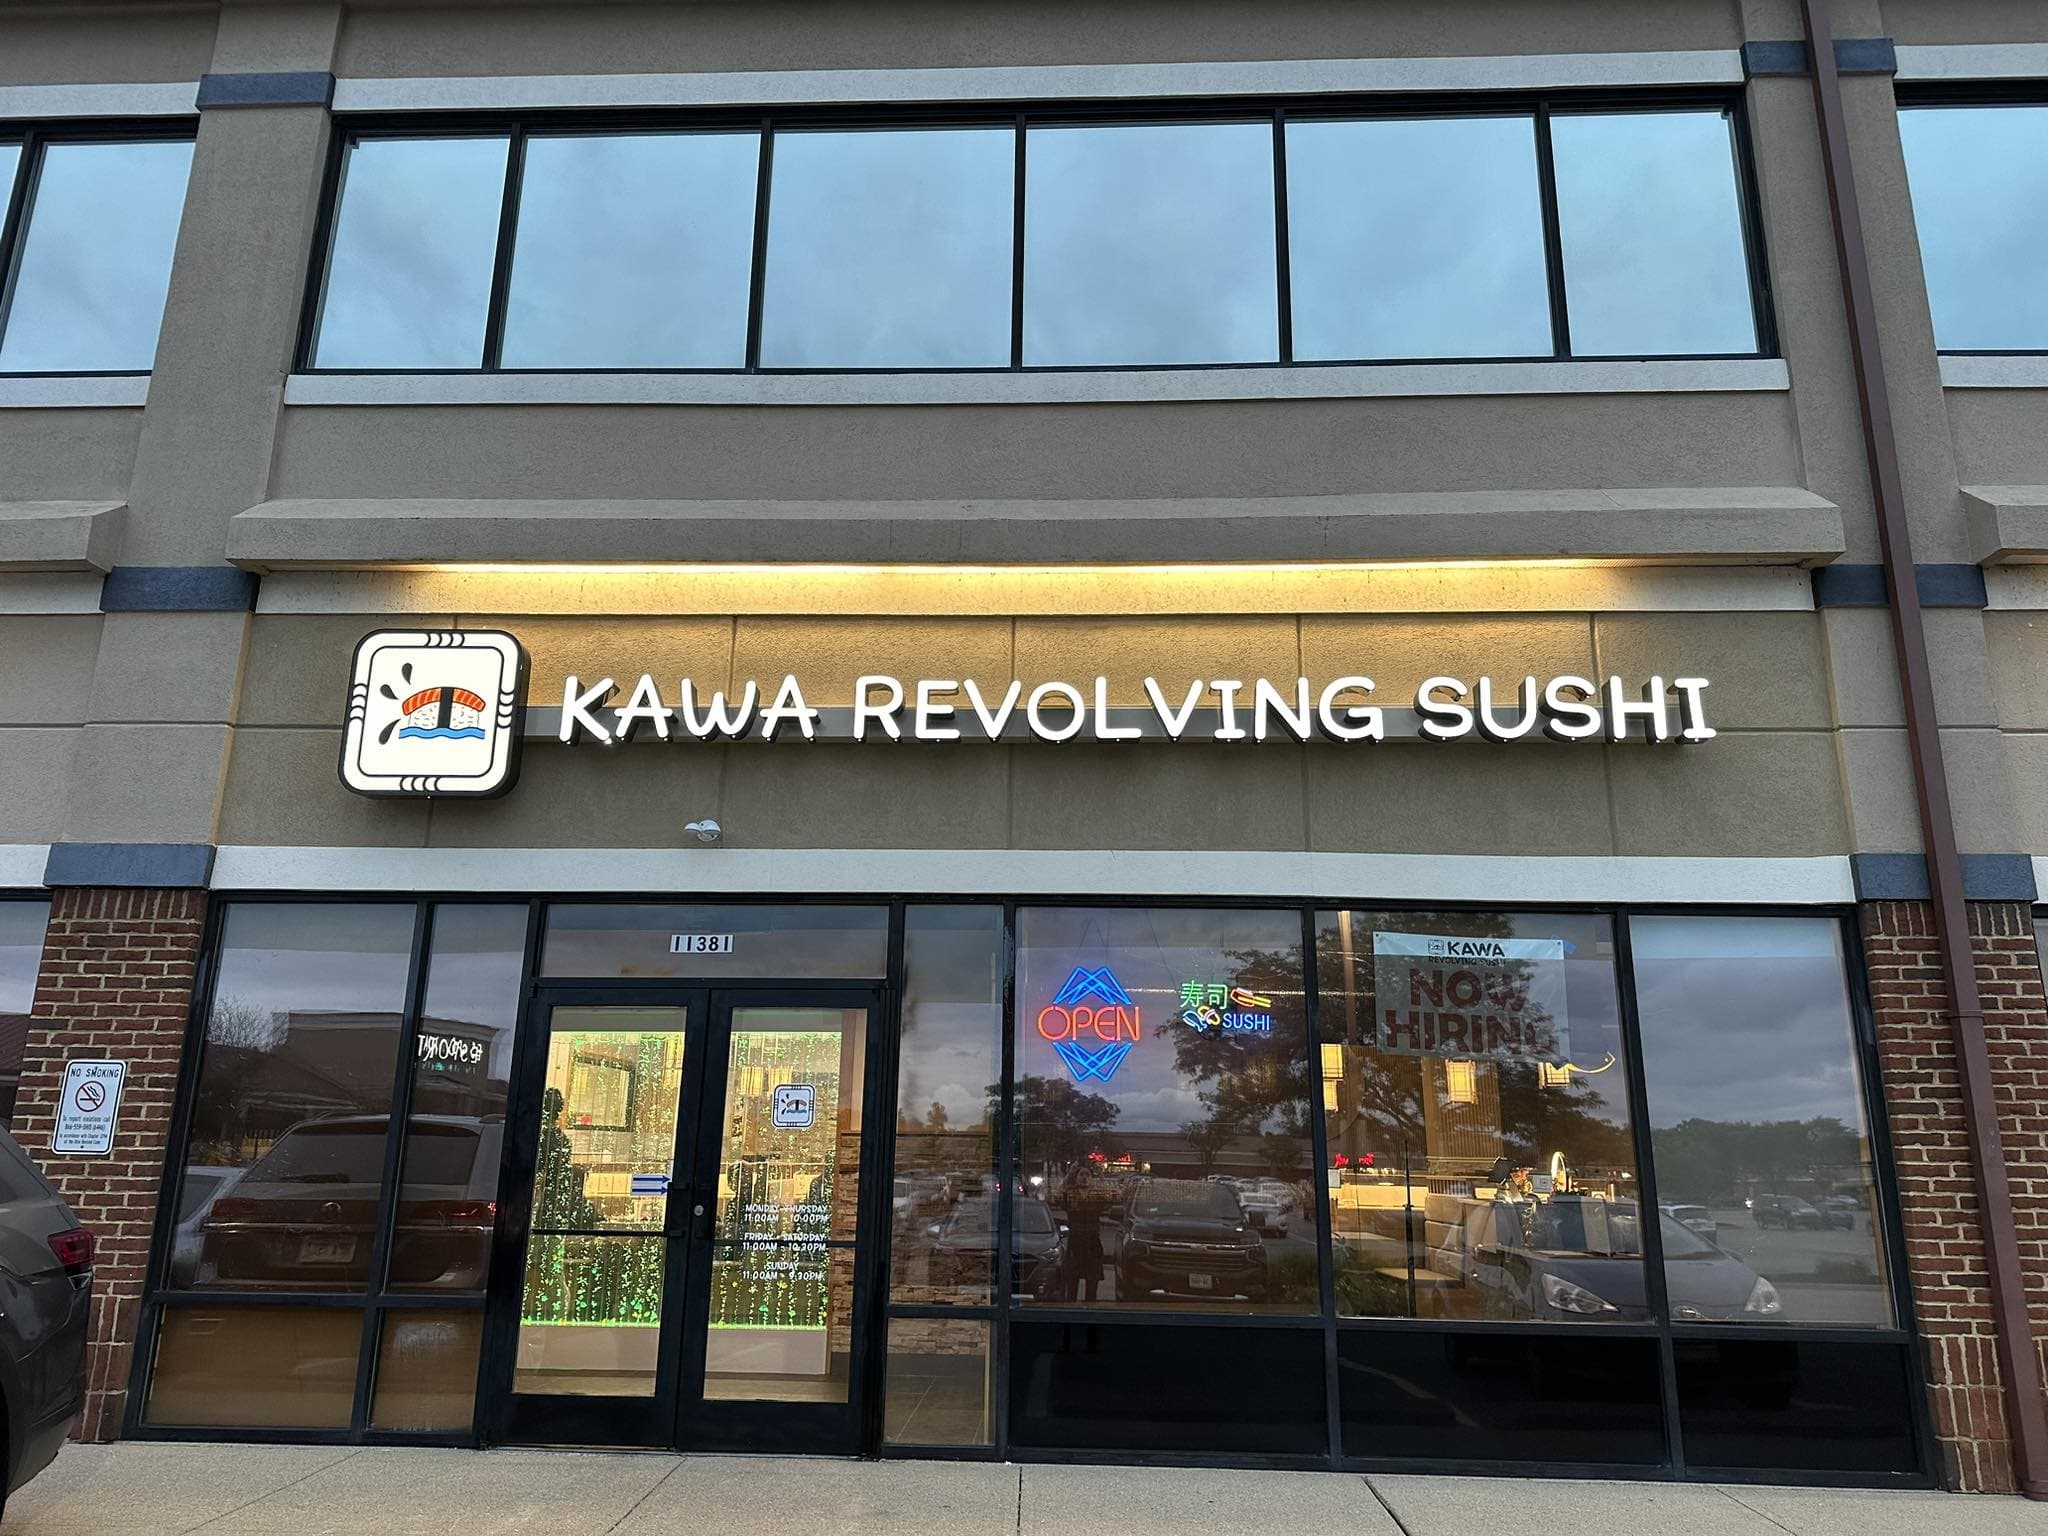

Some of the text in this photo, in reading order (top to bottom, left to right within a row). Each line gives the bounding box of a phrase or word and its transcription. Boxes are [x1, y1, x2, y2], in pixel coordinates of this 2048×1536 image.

[558, 673, 1718, 743] KAWA REVOLVING SUSHI
[674, 935, 730, 952] 11381
[1447, 941, 1506, 957] KAWA
[1428, 956, 1478, 966] REVOLVING
[1180, 979, 1229, 1009] 寿司
[1409, 968, 1532, 1012] NOW
[1038, 1006, 1141, 1041] OPEN
[1222, 1012, 1270, 1031] SUSHI
[70, 1067, 120, 1078] NO SMOKING
[745, 1204, 780, 1213] MONDAY
[744, 1213, 780, 1222] 11:00AM
[744, 1232, 826, 1242] FRIDAY SATURDAY
[742, 1242, 778, 1251] 11:00AM
[766, 1262, 799, 1271] SUNDAY
[742, 1271, 778, 1280] 11:00AM
